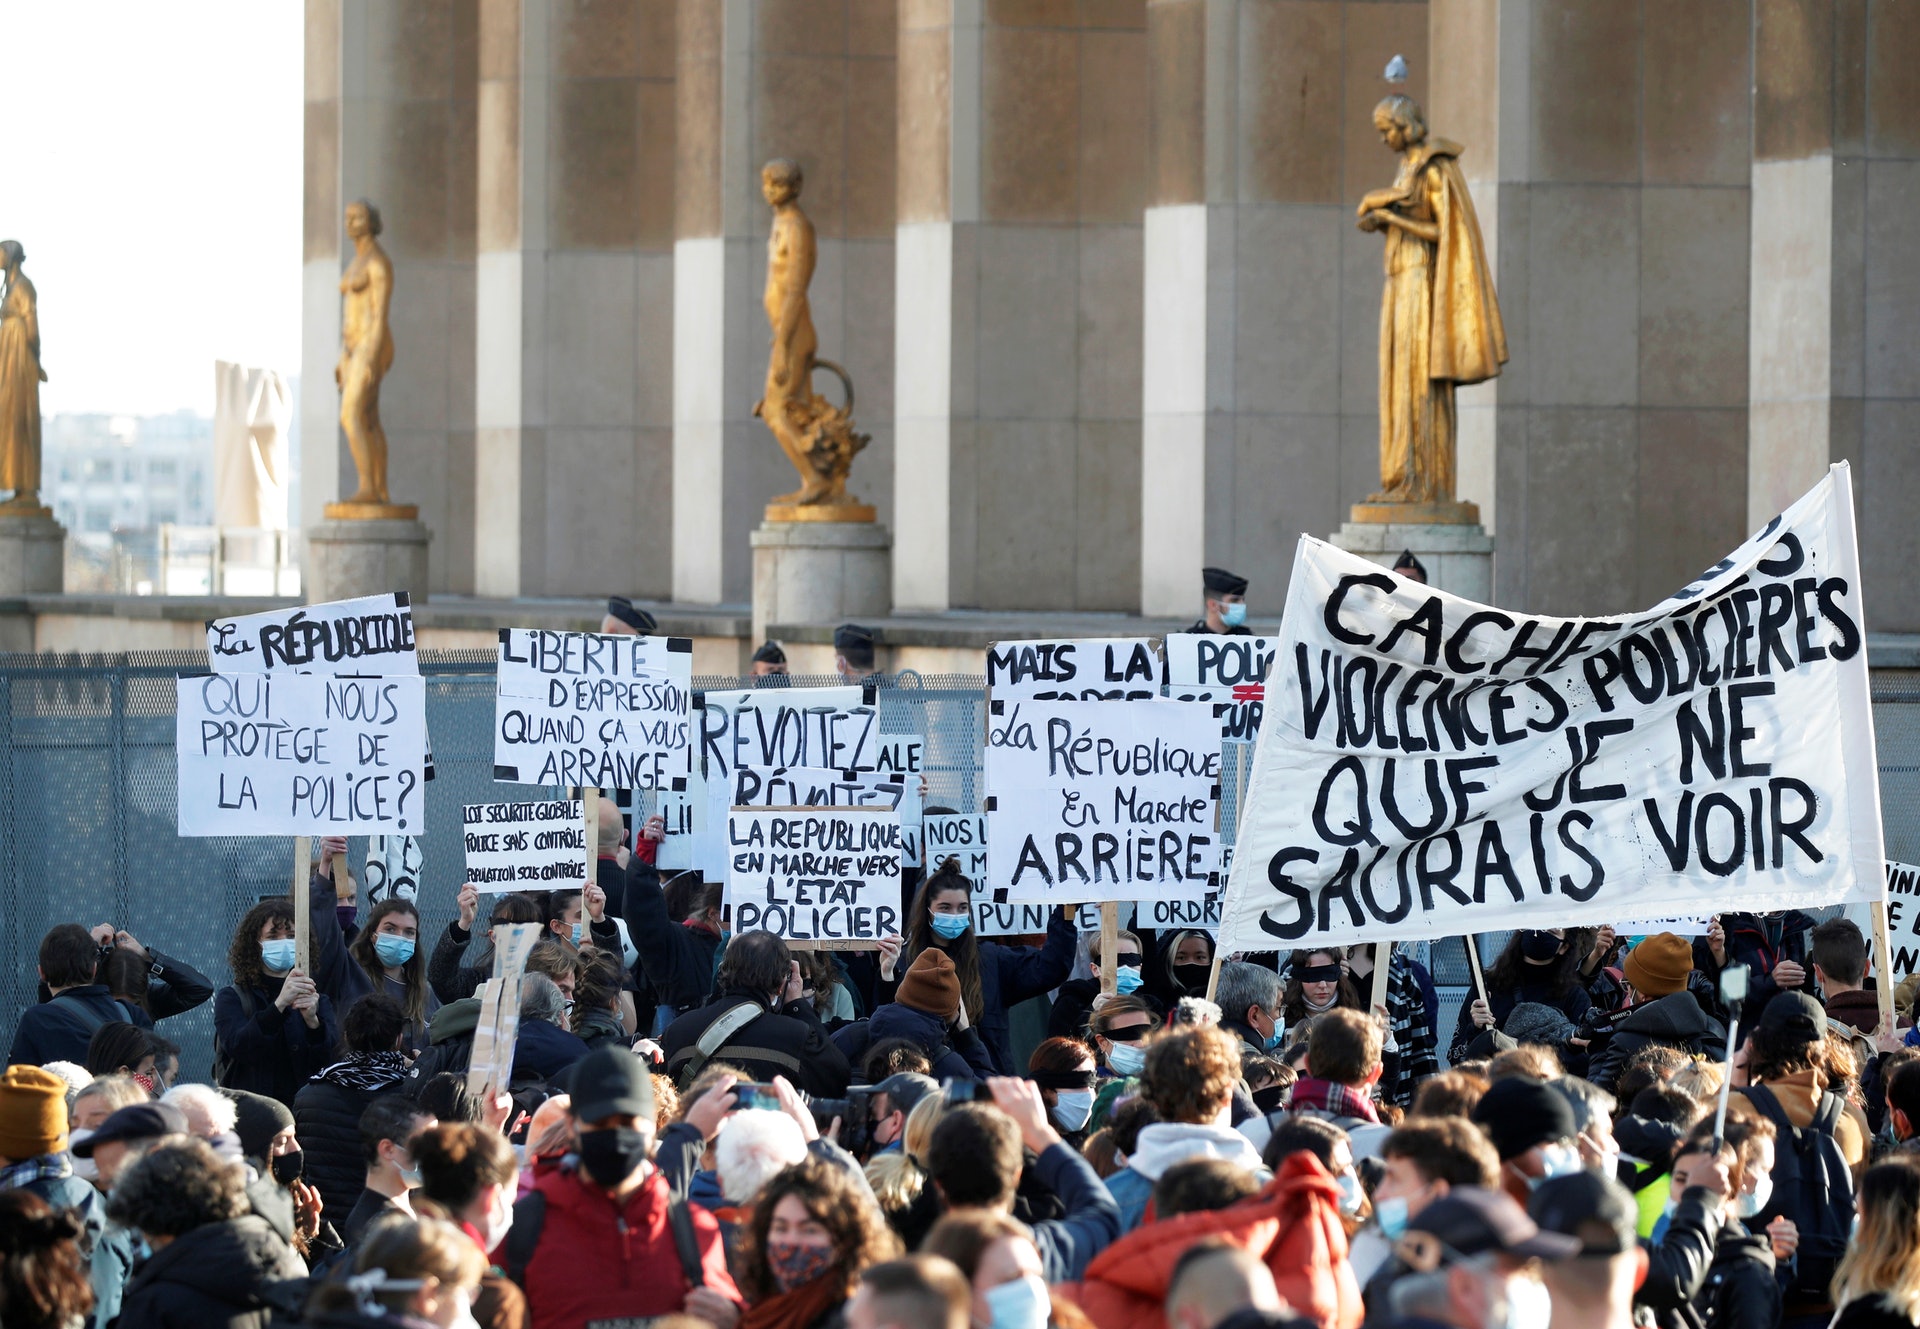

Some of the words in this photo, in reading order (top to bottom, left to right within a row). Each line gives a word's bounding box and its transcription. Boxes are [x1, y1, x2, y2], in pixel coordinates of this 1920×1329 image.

[213, 623, 255, 655] La
[1324, 573, 1672, 675] CACHE
[987, 643, 1077, 686] MAIS
[1105, 643, 1154, 683] LA
[202, 674, 270, 719] QUI
[326, 683, 398, 725] NOUS
[549, 677, 688, 716] D'EXPRESSION
[1296, 642, 1570, 753] VIOLENCES
[202, 717, 331, 764] PROTÈGE
[359, 733, 390, 766] DE
[502, 710, 584, 744] QUAND
[599, 718, 628, 749] ÇA
[640, 718, 688, 750] VOUS
[990, 703, 1038, 751] La
[537, 748, 669, 791] ARRANGE
[877, 743, 922, 773] ALE
[1312, 755, 1500, 846] QUE
[1523, 719, 1634, 812] JE
[1676, 682, 1775, 784] NE
[219, 773, 257, 811] LA
[1062, 788, 1100, 828] En
[466, 832, 499, 853] POLICE
[503, 830, 529, 851] SANS
[730, 818, 764, 848] LA
[770, 818, 902, 852] REPUBLIQUE
[929, 819, 973, 846] NOS
[467, 864, 516, 883] POPULATION
[734, 853, 764, 873] EN
[771, 853, 853, 876] MARCHE
[857, 855, 900, 877] VERS
[1011, 829, 1210, 888] ARRIÈRE
[1259, 810, 1606, 940] SAURAIS
[1643, 777, 1823, 877] VOIR
[737, 902, 900, 938] POLICIER
[1610, 1010, 1632, 1021] Canon
